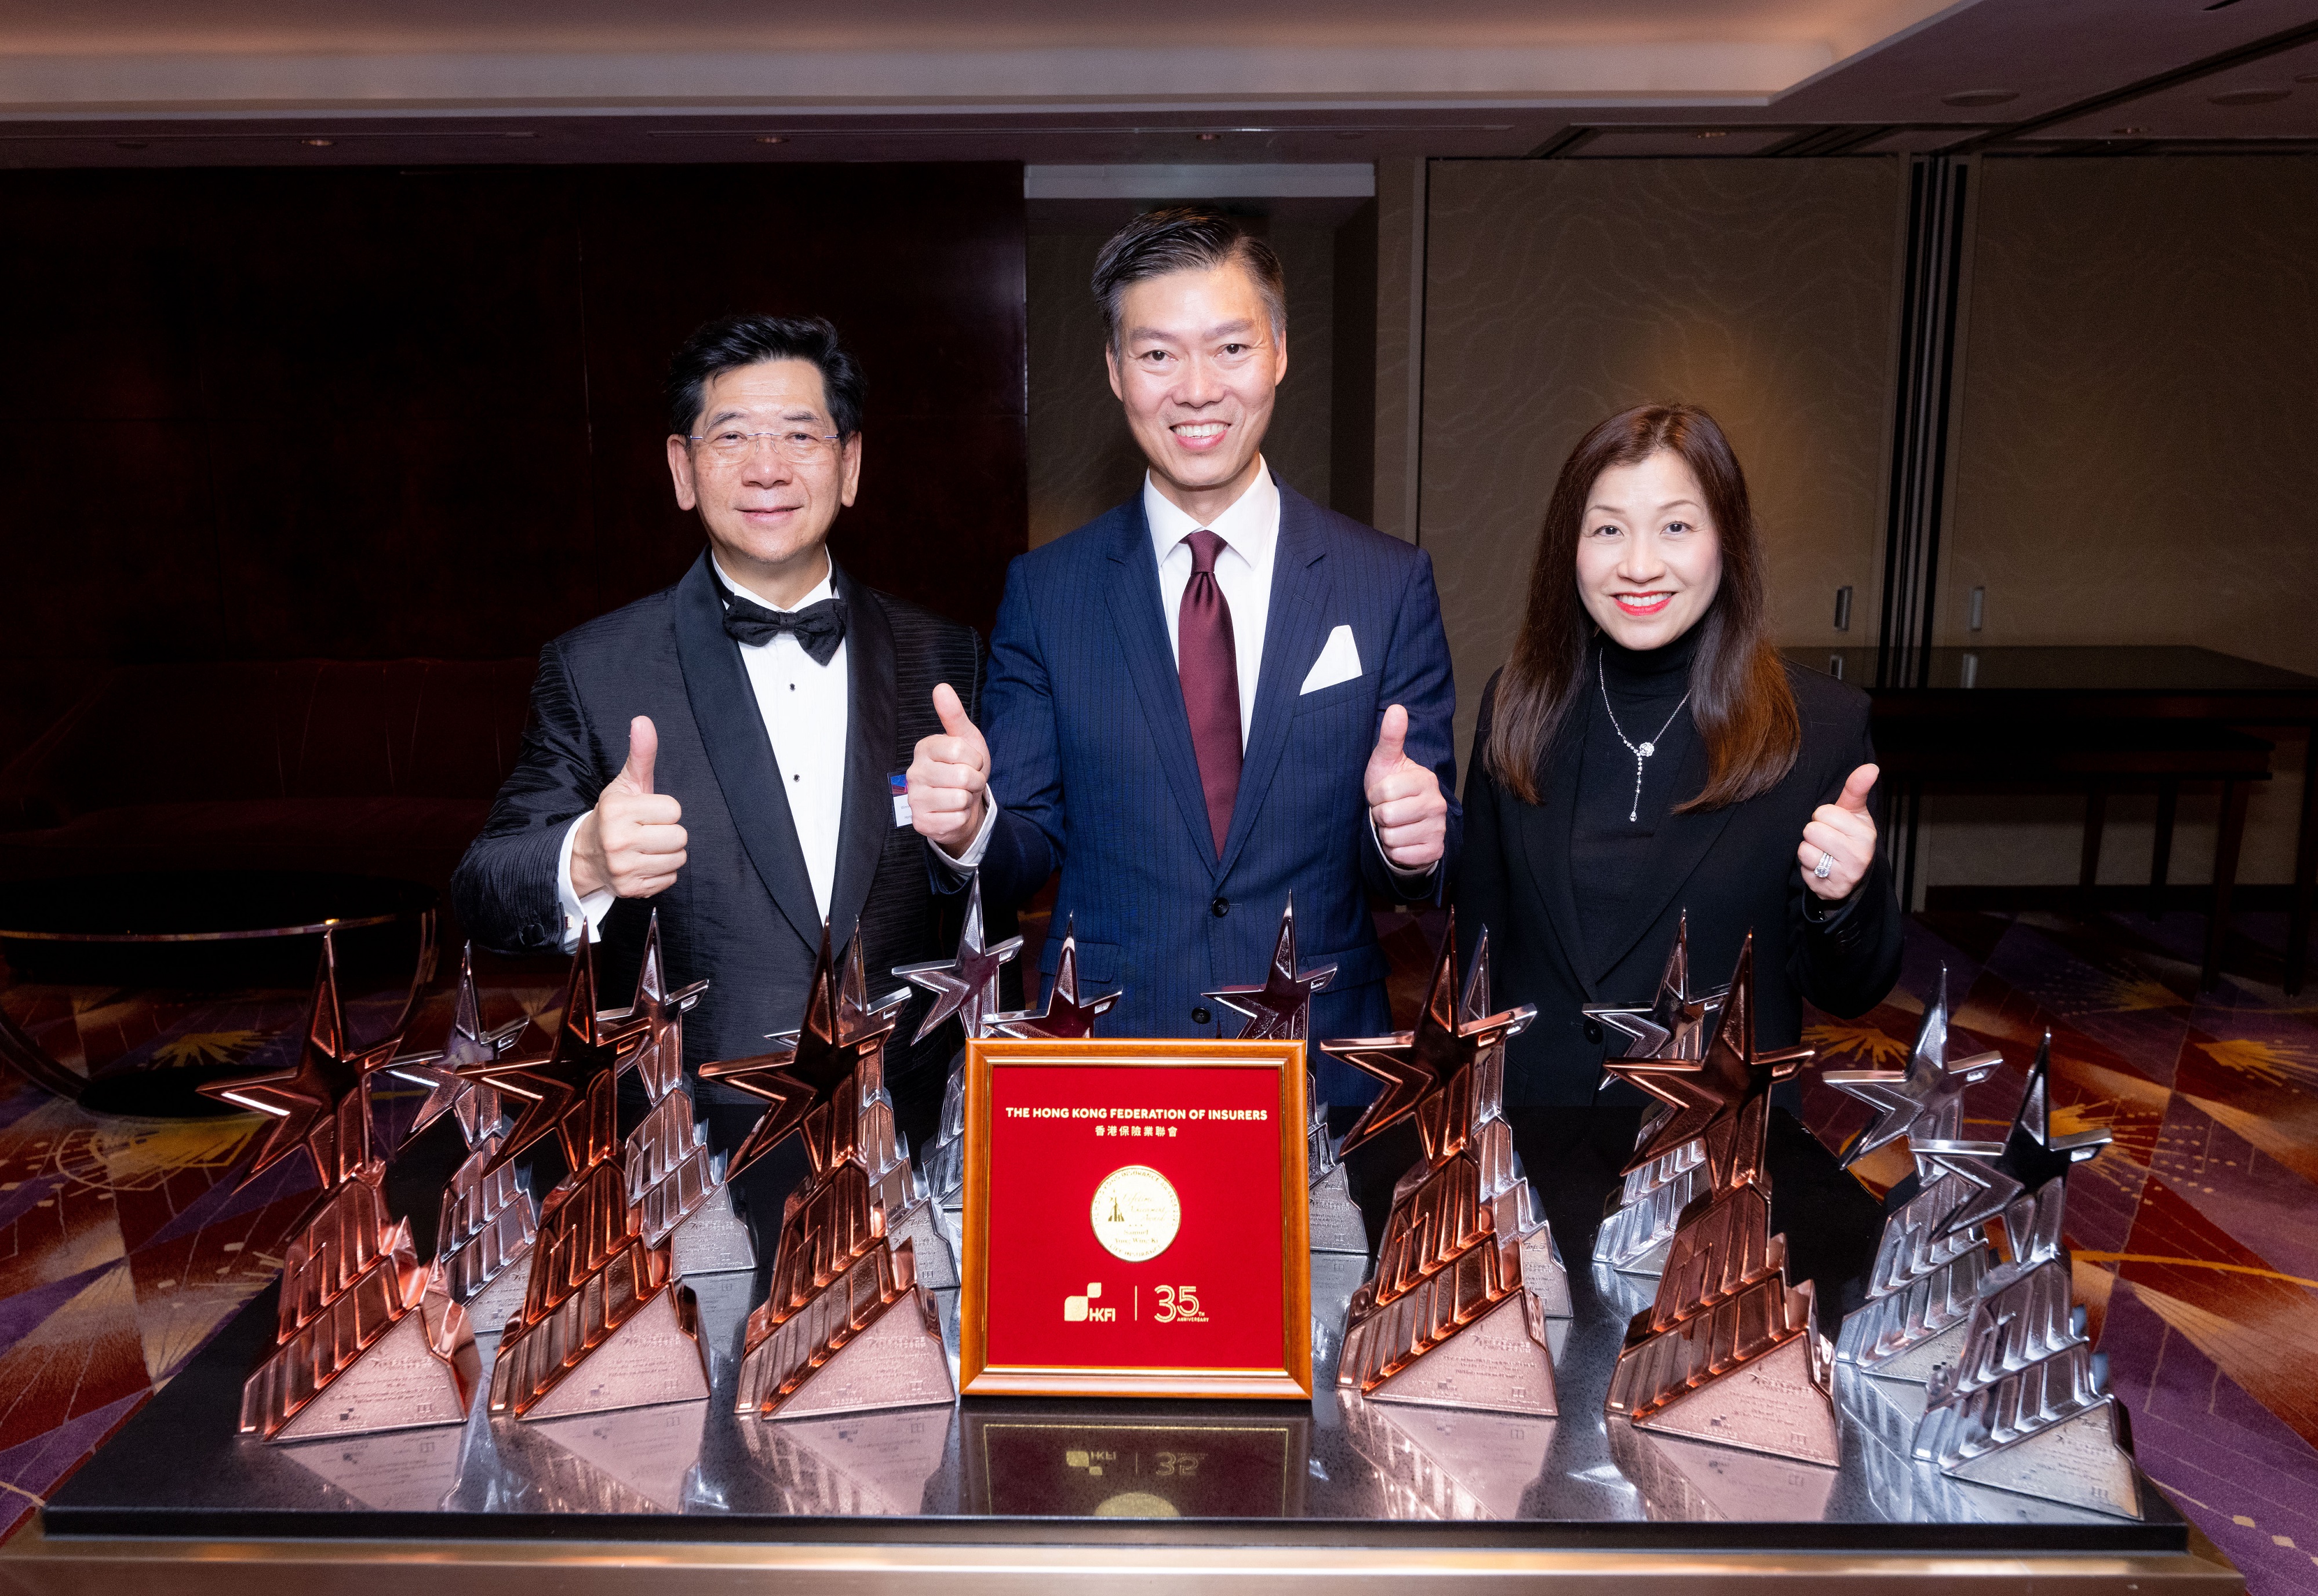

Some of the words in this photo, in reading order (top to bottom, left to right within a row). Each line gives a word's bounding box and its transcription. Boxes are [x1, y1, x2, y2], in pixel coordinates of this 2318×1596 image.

[1005, 1107, 1030, 1118] THE
[1033, 1107, 1069, 1118] HONG
[1072, 1108, 1107, 1119] KONG
[1110, 1108, 1186, 1120] FEDERATION
[1189, 1109, 1206, 1120] OF
[1208, 1109, 1268, 1120] INSURERS
[1095, 1125, 1178, 1138] 香港保險業聯會
[1121, 1170, 1160, 1182] INSURANCE
[1089, 1307, 1116, 1322] HKFI
